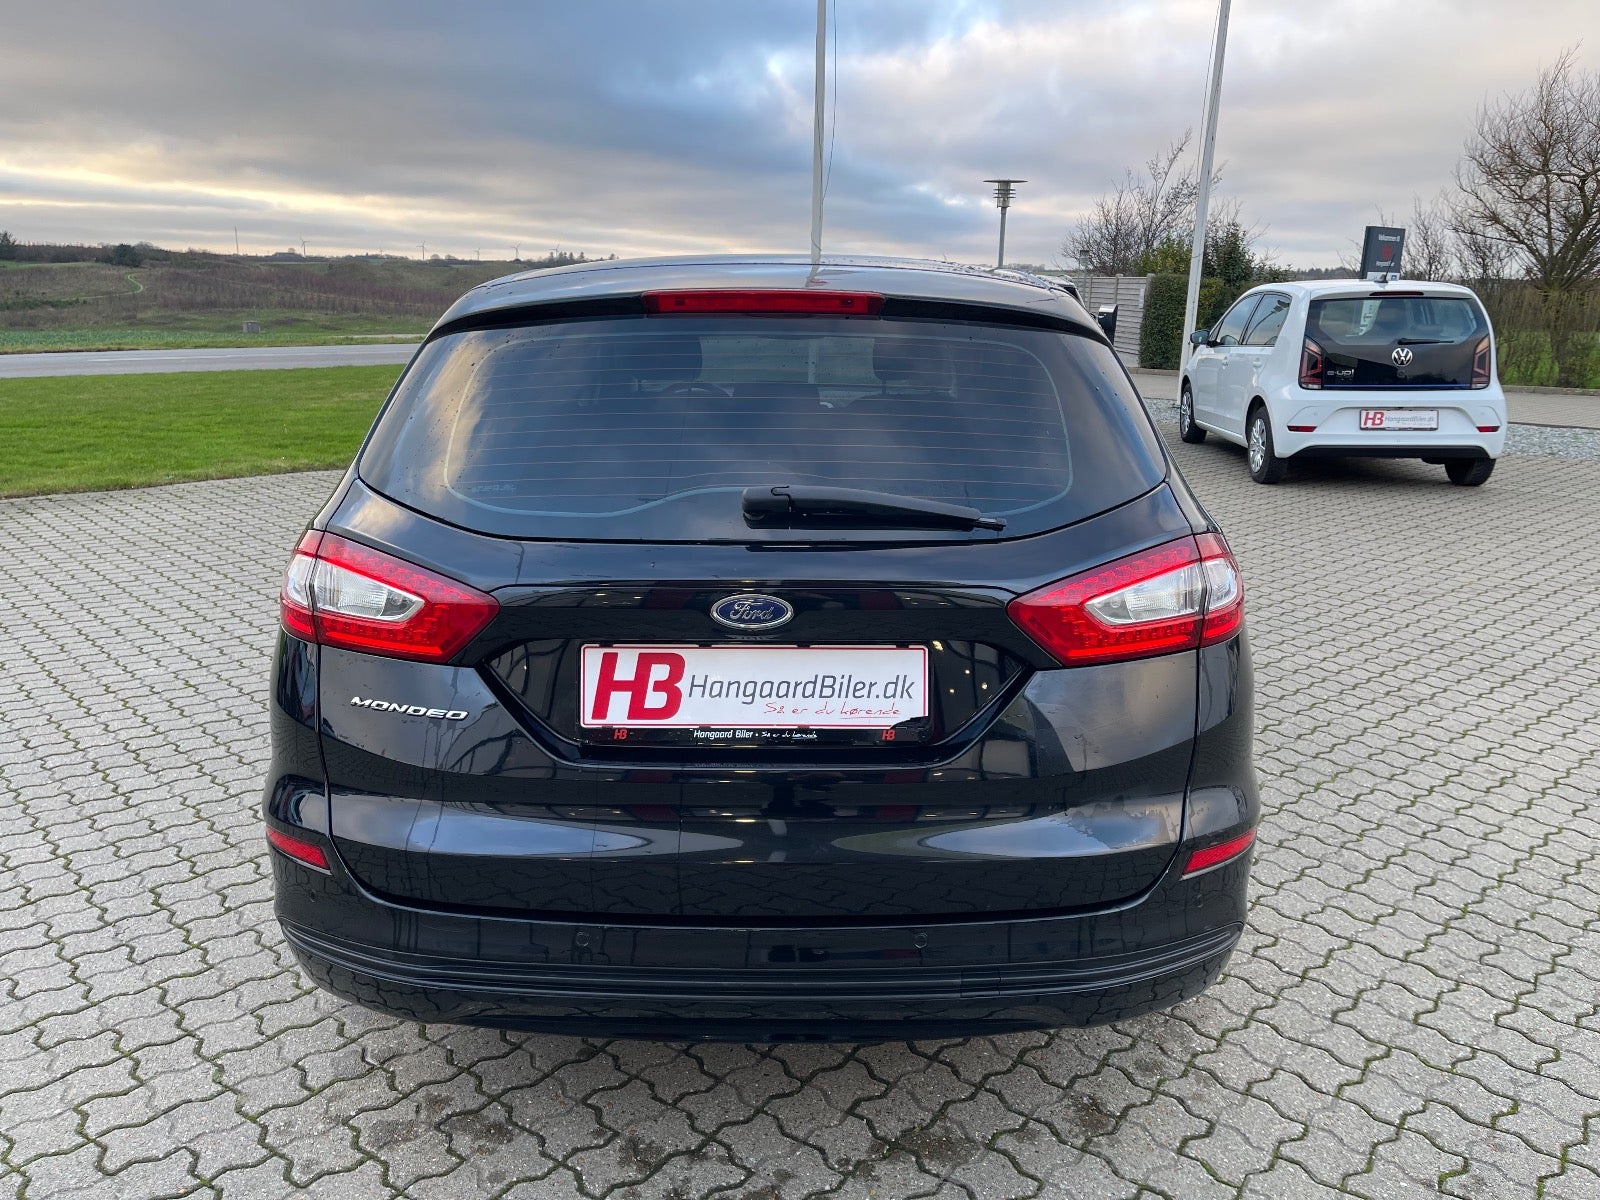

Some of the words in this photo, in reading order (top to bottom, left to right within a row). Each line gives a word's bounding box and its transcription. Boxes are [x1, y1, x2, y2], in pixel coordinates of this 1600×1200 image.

[1363, 411, 1385, 426] HB
[729, 600, 775, 620] Ford
[591, 652, 686, 721] HB
[688, 674, 915, 705] HangaardBiler.dk
[350, 696, 469, 720] MONDEO
[791, 707, 809, 715] er
[815, 701, 835, 715] du
[613, 729, 628, 740] HB
[693, 730, 734, 740] Hangaard
[735, 730, 754, 738] Biler
[881, 730, 896, 740] HB
